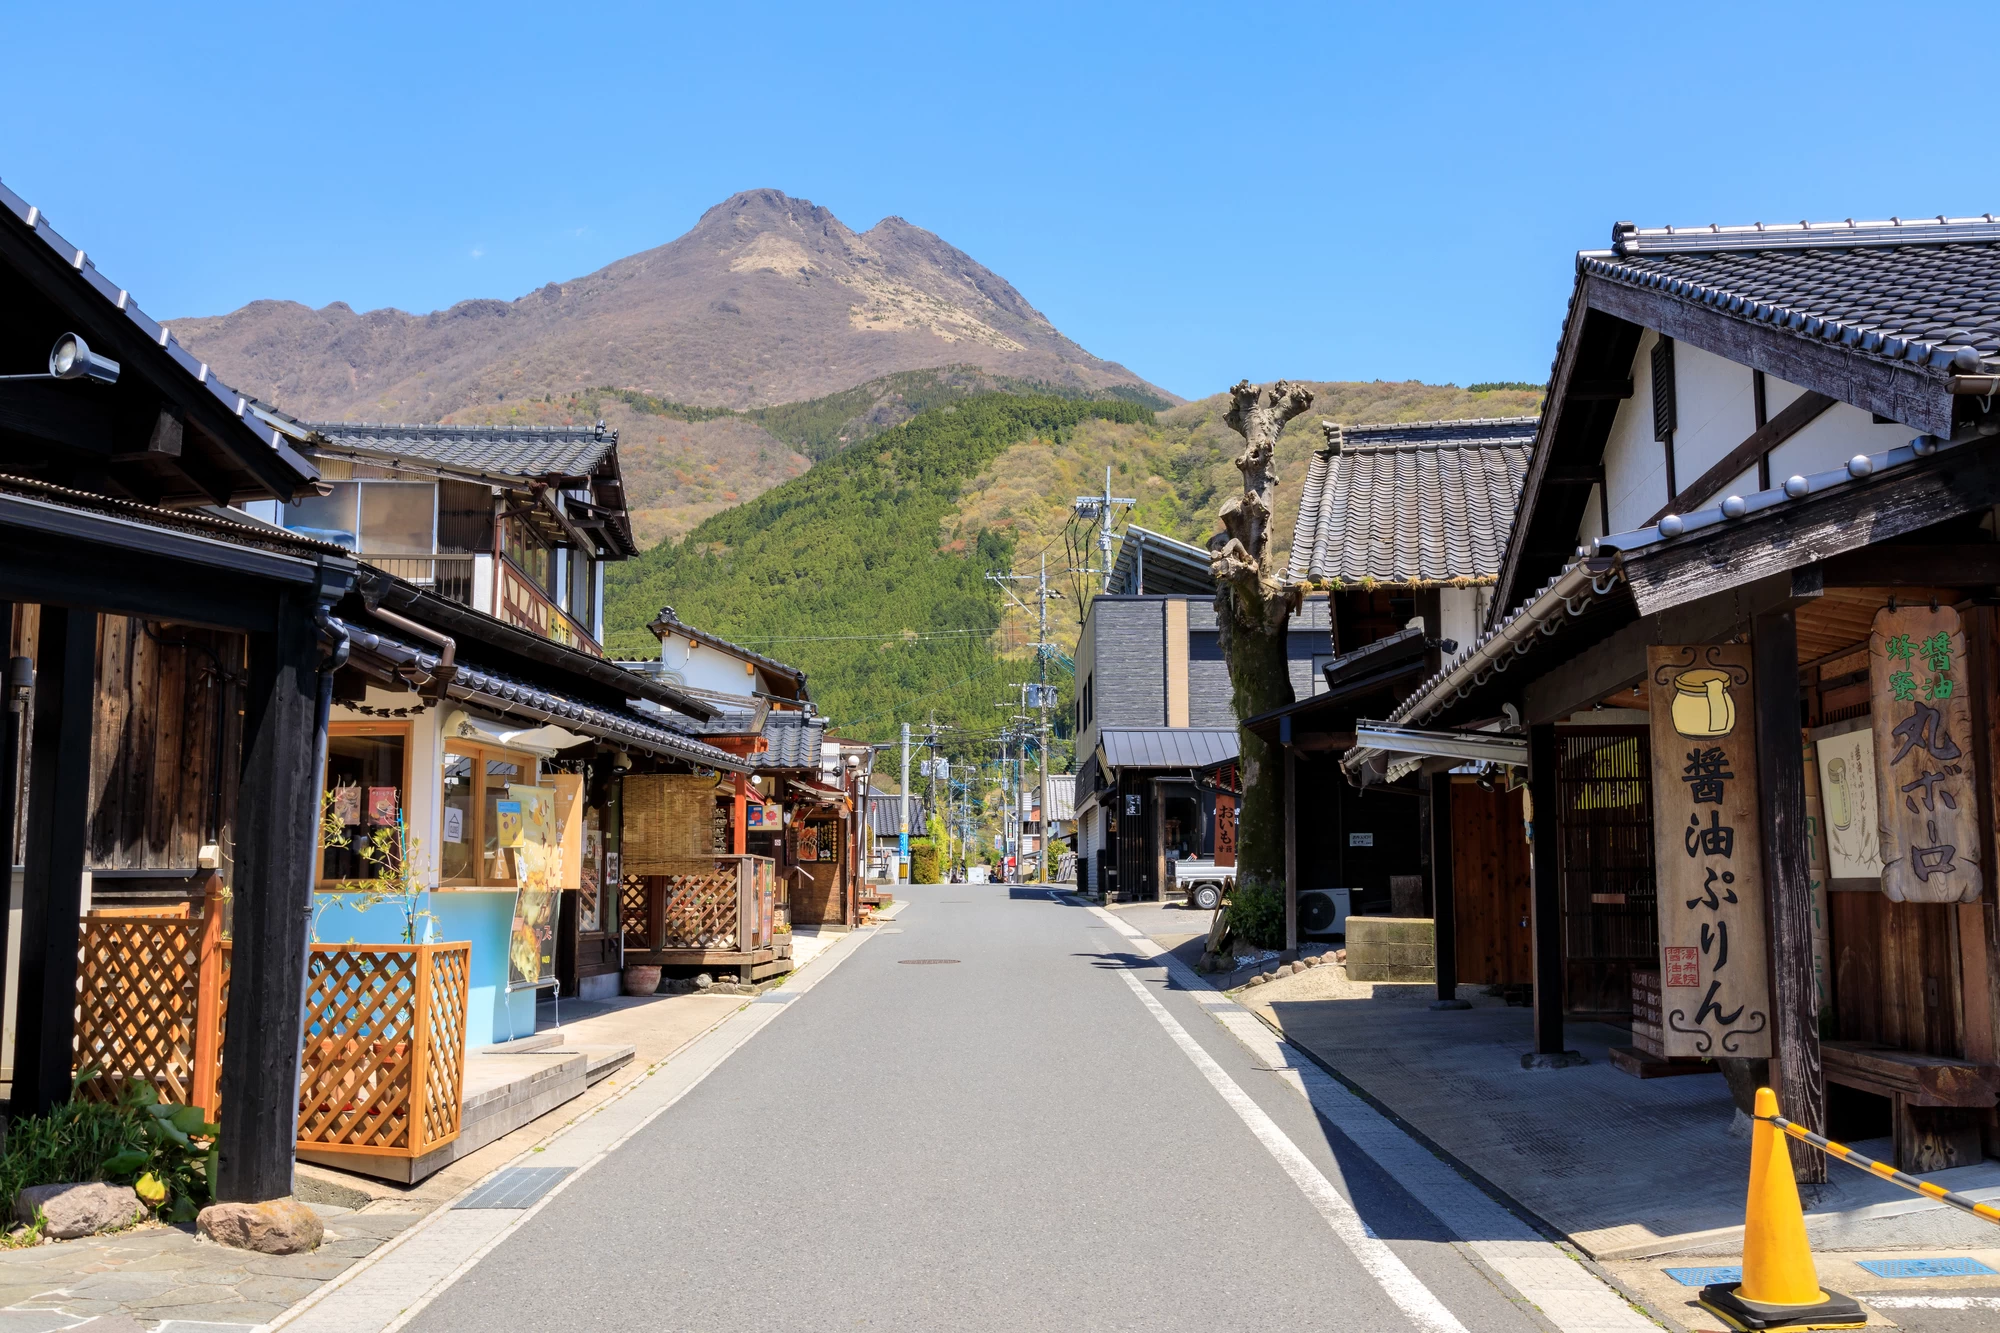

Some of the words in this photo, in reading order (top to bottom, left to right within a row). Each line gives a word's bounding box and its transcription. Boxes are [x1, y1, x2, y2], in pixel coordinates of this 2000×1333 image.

[1885, 633, 1919, 701] 蜂蜜
[1920, 631, 1954, 700] 醤油
[1219, 805, 1234, 844] おいも
[1891, 701, 1962, 883] 丸ボーロ
[1682, 747, 1744, 1026] 醤油ぷりん
[1681, 949, 1698, 985] 湯布院
